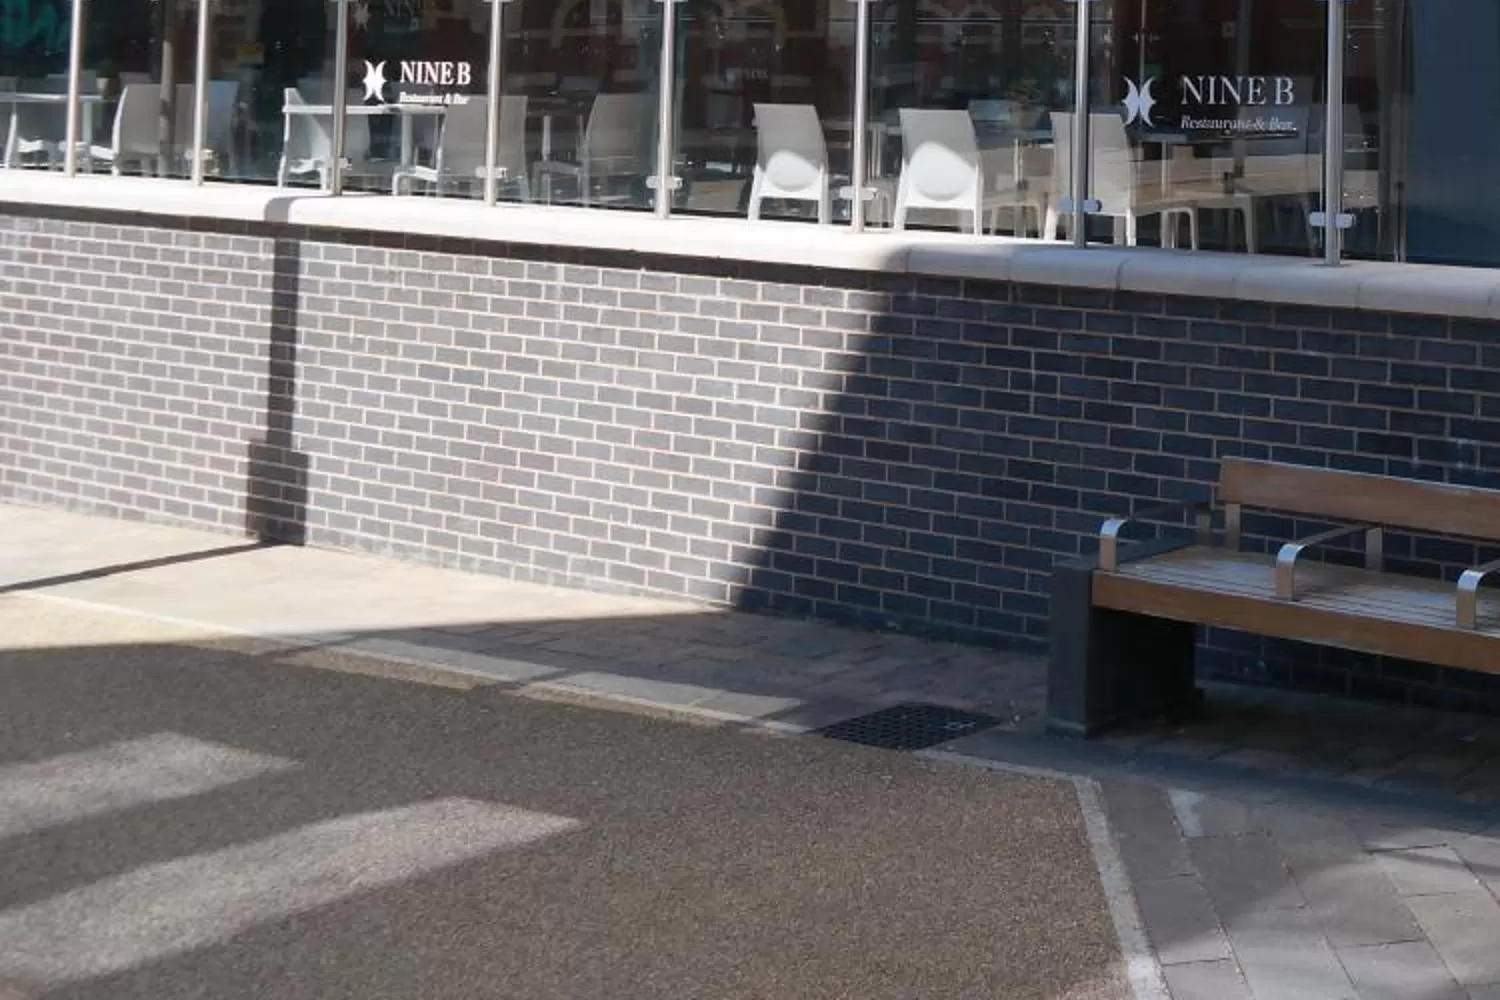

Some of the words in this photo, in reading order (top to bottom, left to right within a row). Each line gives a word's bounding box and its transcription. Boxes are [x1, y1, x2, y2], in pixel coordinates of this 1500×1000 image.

[400, 60, 454, 85] NINE
[457, 60, 471, 85] B
[1181, 75, 1267, 105] NINE
[1275, 76, 1294, 105] B
